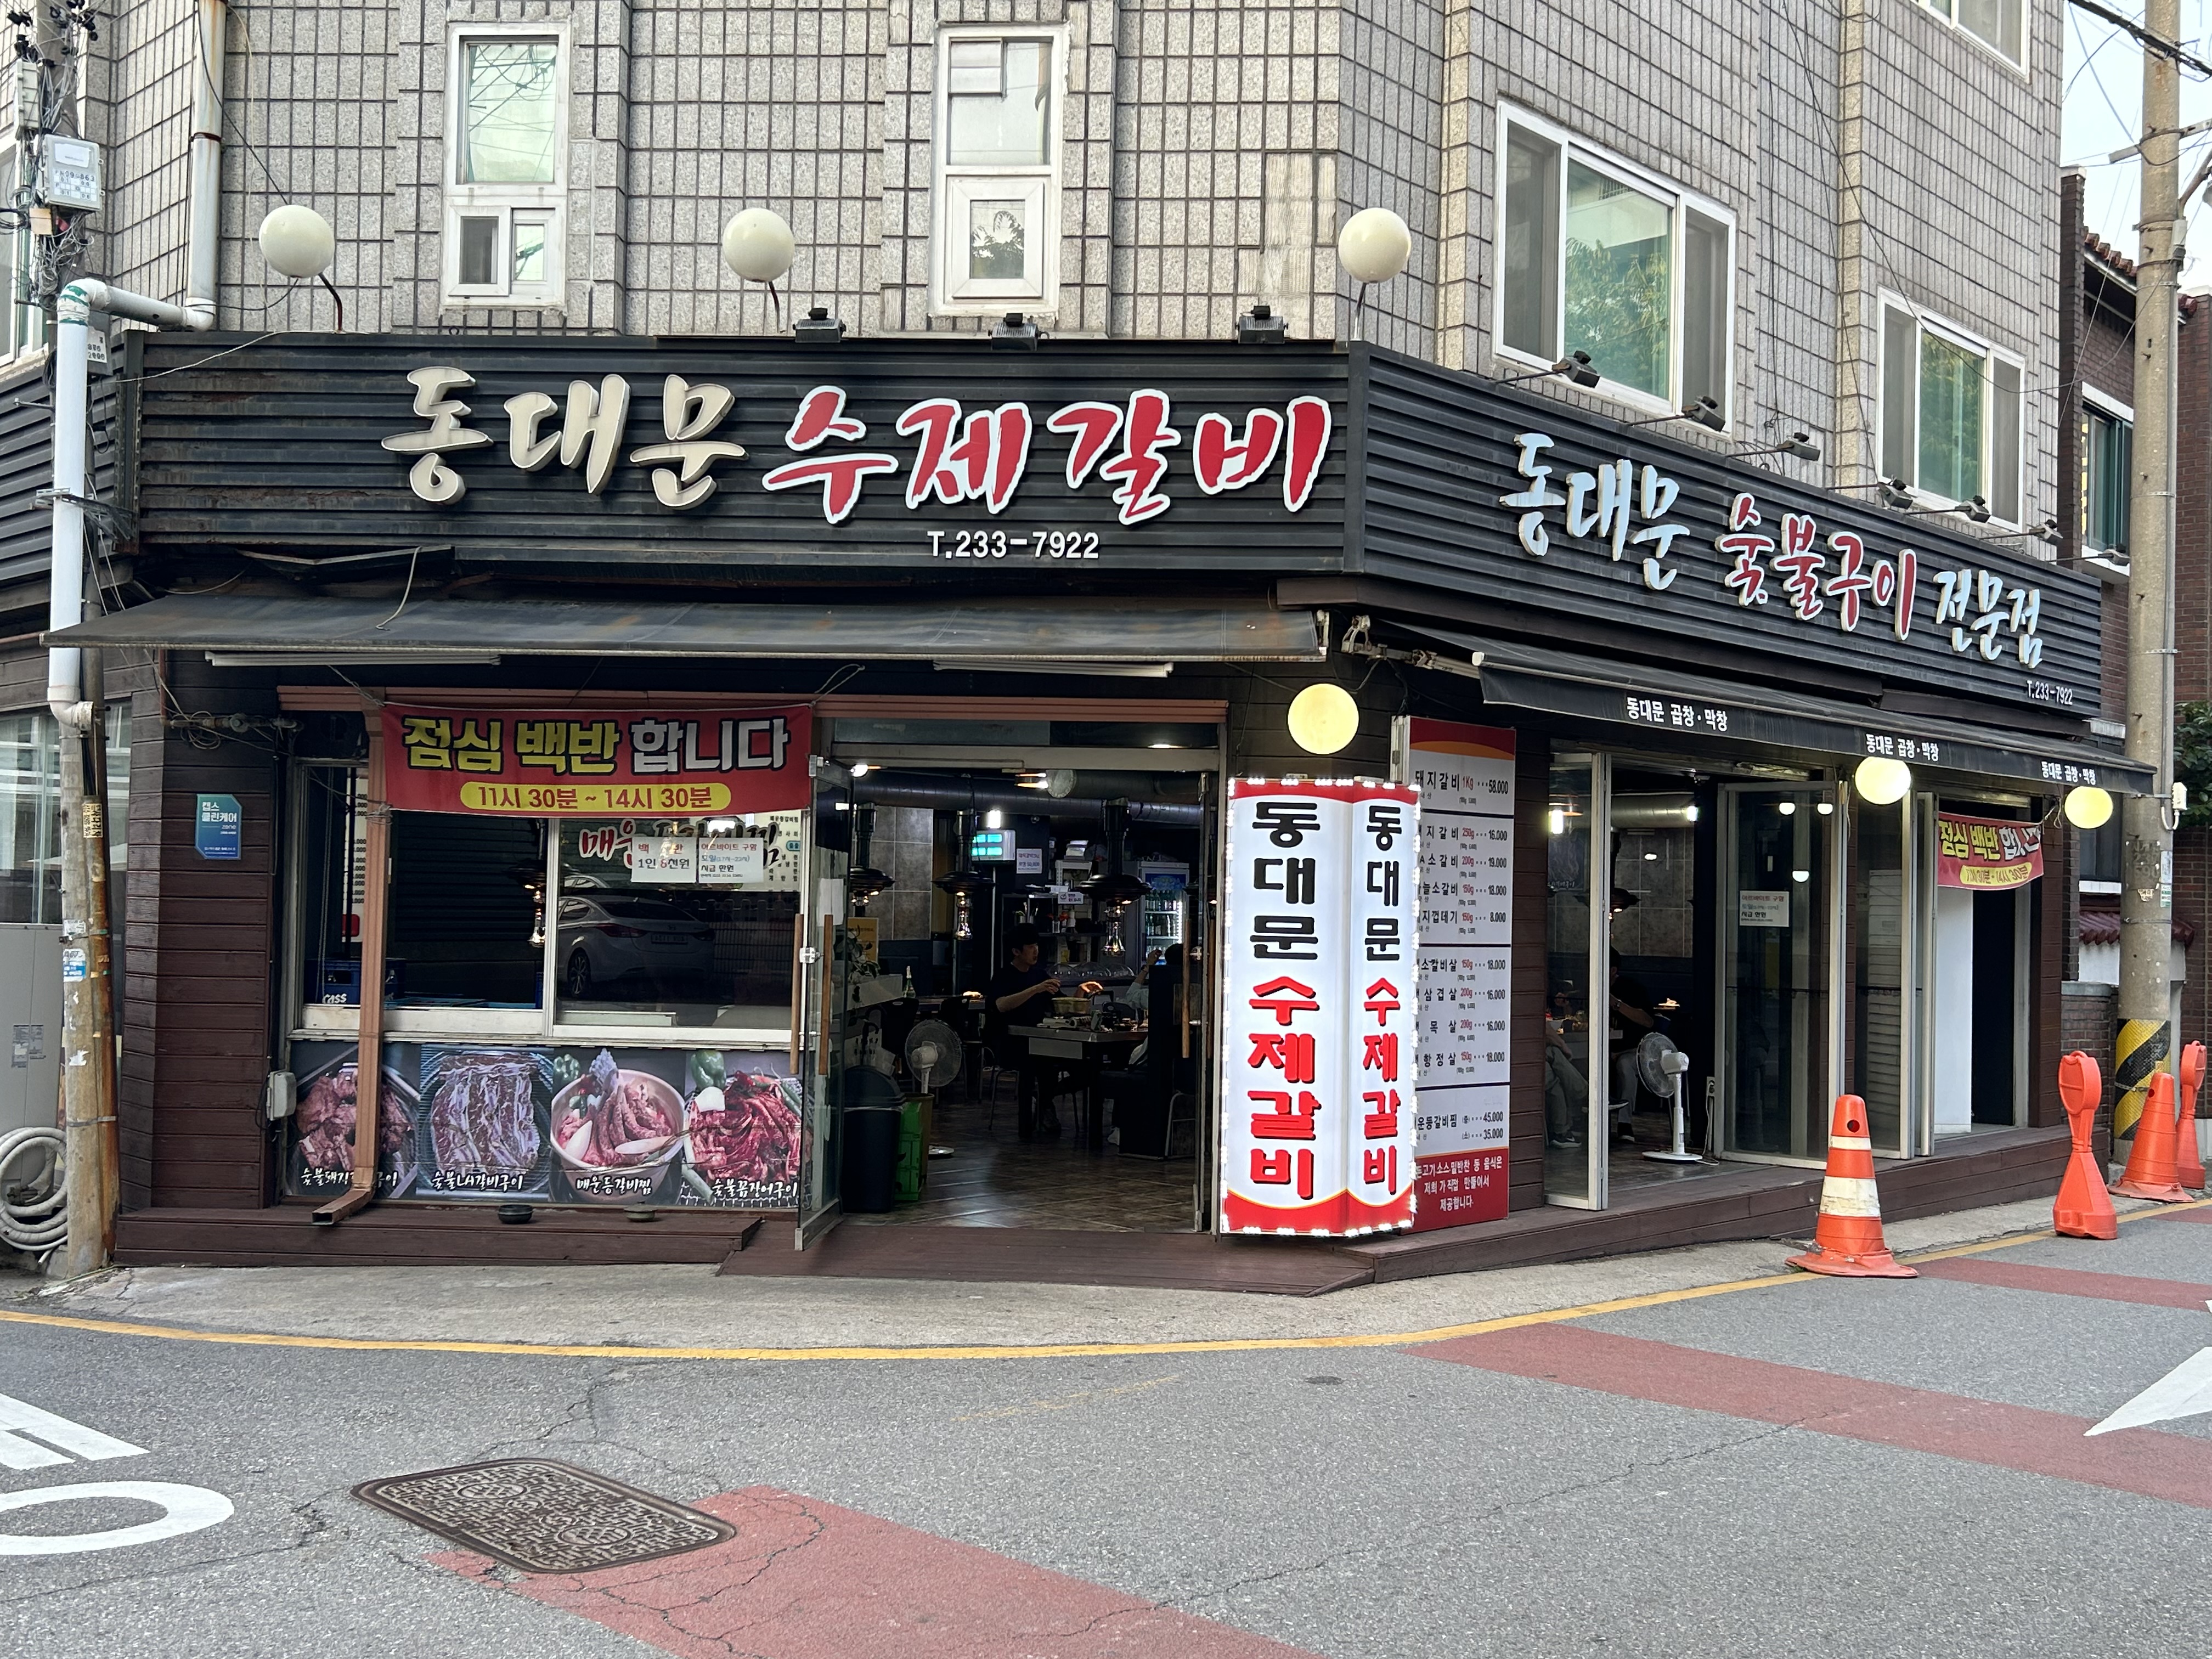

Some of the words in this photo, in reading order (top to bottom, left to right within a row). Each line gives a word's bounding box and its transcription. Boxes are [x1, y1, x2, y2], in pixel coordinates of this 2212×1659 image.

[381, 366, 749, 510] 동대문
[762, 385, 1331, 525] 수제갈비
[927, 531, 1099, 560] T.233-7922
[1499, 433, 1690, 590] 동대문
[1715, 492, 1916, 641] 숯불구이
[1933, 568, 2043, 669] 전문점
[2027, 680, 2073, 705] T.233-7922
[1627, 697, 1664, 723] 동대문
[402, 716, 504, 774] 점심
[515, 718, 620, 775] 백반
[630, 716, 789, 774] 합니다
[1866, 733, 1893, 755] 동대문
[2041, 761, 2062, 780] 동대문
[202, 802, 219, 811] 캡스
[478, 787, 521, 809] 11시
[528, 788, 578, 809] 30분
[605, 788, 653, 809] 14시
[661, 786, 712, 809] 30분
[201, 812, 237, 822] 클린케어
[1938, 821, 1969, 859] 점심
[1970, 825, 2001, 860] 백반
[1419, 853, 1458, 868] A소갈비
[1250, 802, 1321, 960] 동대문
[1365, 806, 1402, 961] 동대문
[1247, 976, 1321, 1200] 수제갈비
[1362, 978, 1401, 1194] 수제갈비
[1414, 1113, 1457, 1131] 운등갈비찜
[301, 1167, 398, 1189] 숯불돼지구이
